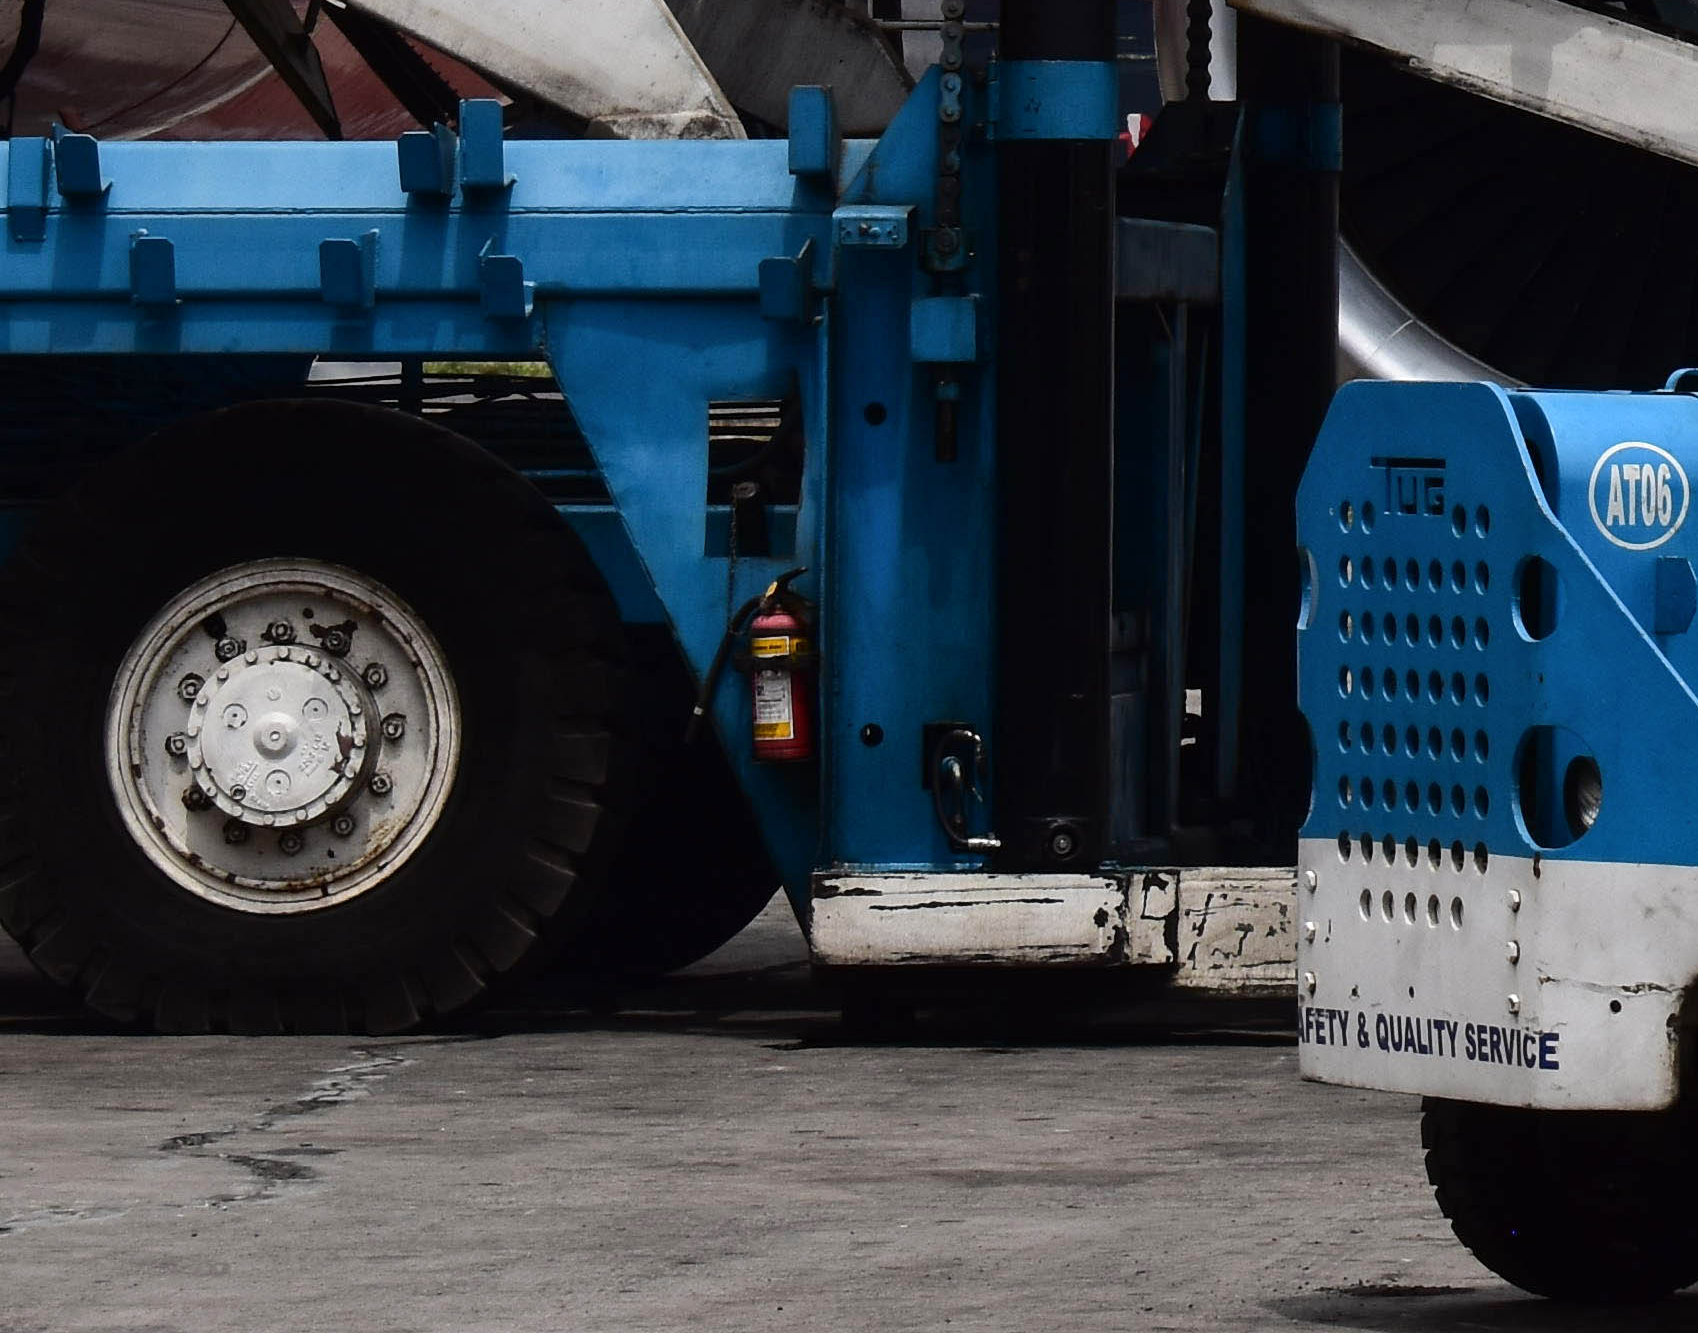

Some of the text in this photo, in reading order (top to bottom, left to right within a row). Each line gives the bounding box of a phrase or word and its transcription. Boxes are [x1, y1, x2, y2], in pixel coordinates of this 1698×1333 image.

[1371, 456, 1446, 515] TUG
[1607, 464, 1672, 526] AT06
[1357, 1012, 1369, 1048] &
[1376, 1013, 1458, 1058] QUALITY
[1465, 1023, 1559, 1070] SERVICE
